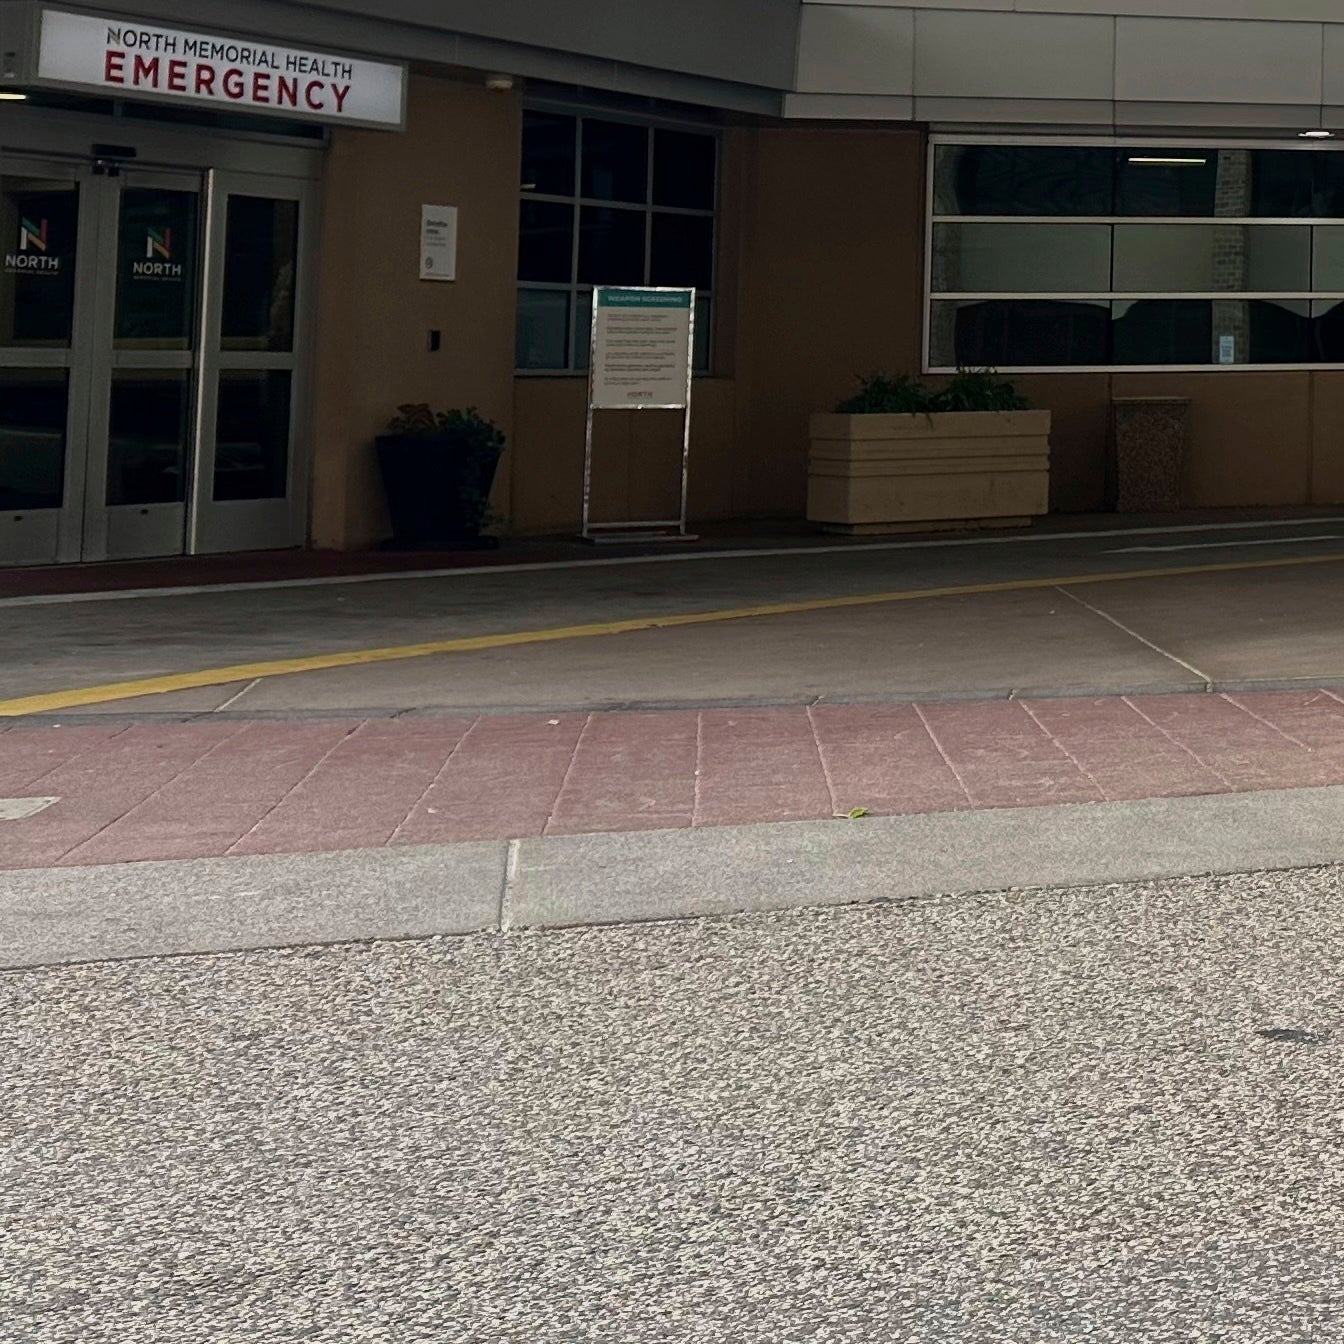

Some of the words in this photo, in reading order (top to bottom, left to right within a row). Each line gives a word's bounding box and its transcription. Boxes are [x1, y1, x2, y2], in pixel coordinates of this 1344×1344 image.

[106, 26, 177, 54] NORTH
[183, 39, 280, 70] MEMORIAL
[285, 54, 353, 80] HEALTH
[104, 50, 351, 113] EMERGENCY
[5, 254, 59, 271] NORTH
[132, 261, 183, 277] NORTH
